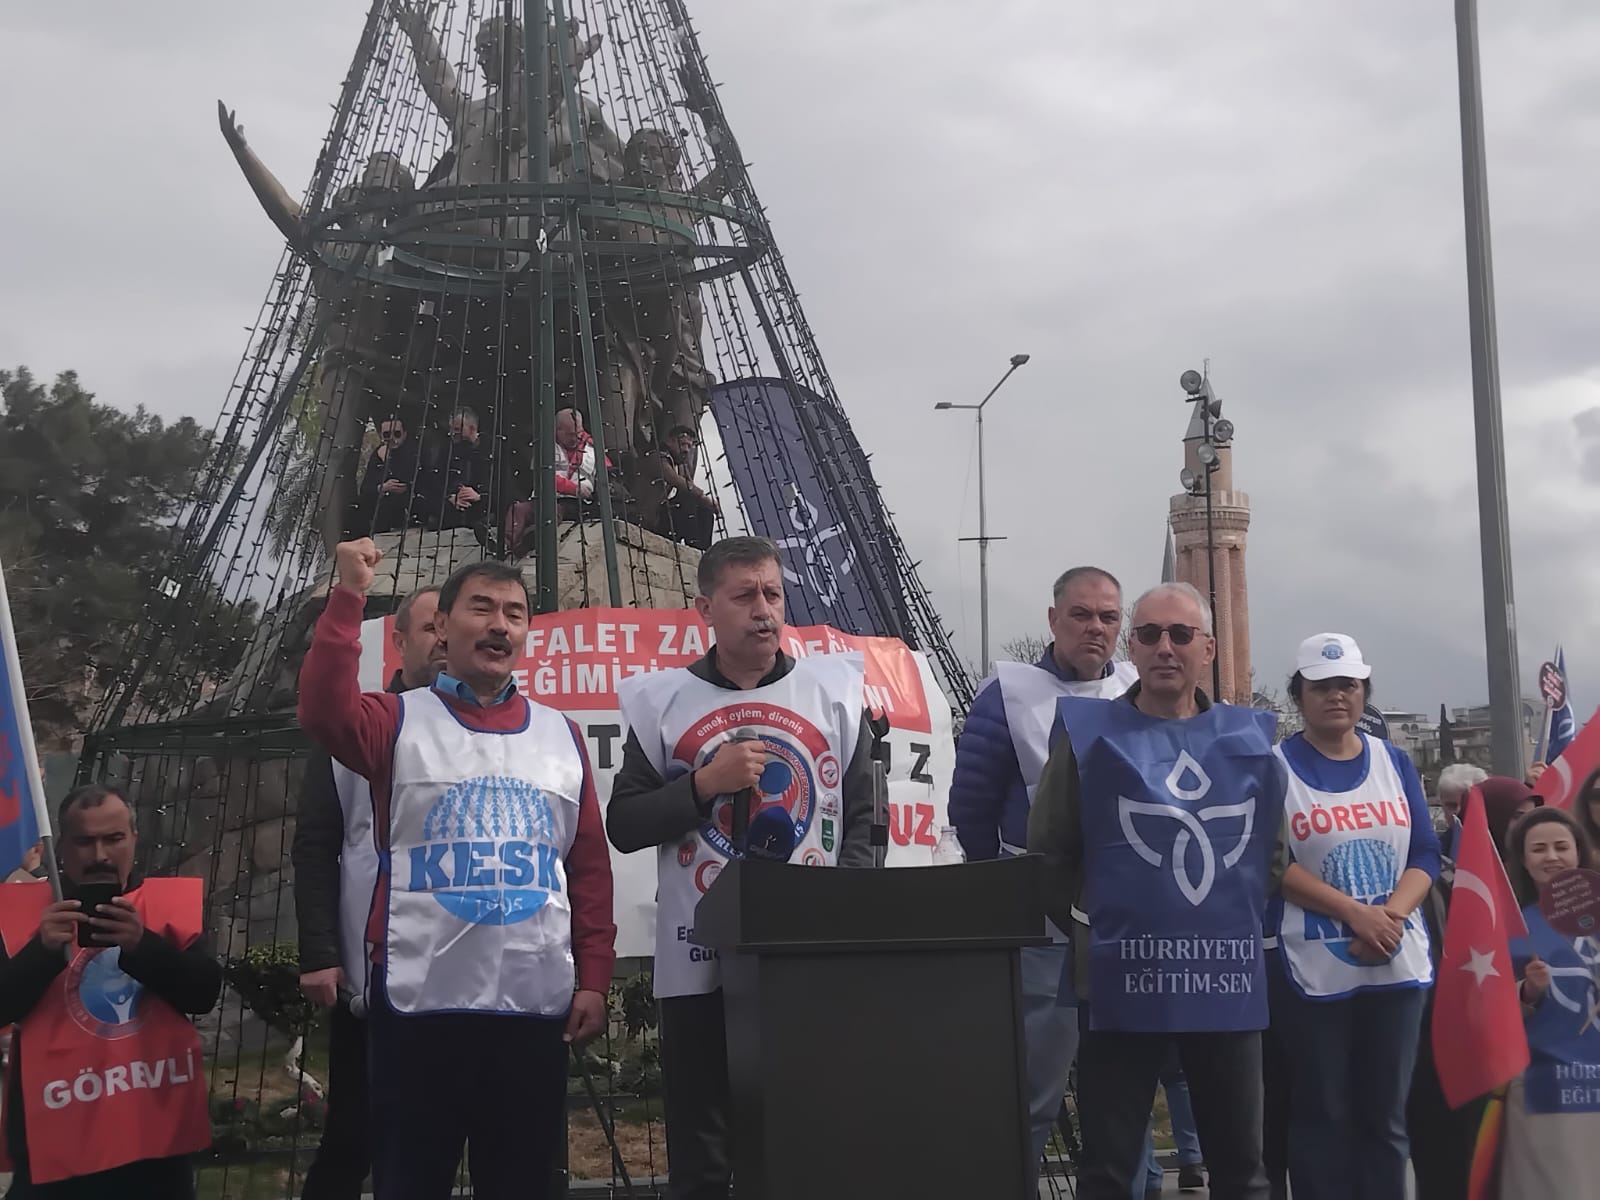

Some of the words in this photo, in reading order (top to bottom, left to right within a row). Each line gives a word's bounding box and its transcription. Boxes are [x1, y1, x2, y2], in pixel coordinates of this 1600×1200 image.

[525, 623, 640, 658] FALET
[696, 714, 728, 737] emek,
[729, 708, 766, 721] eylem,
[1291, 796, 1410, 842] GÖREVLİ
[408, 840, 562, 893] KESK
[1120, 934, 1255, 965] HÜRRİYETÇİ
[1125, 968, 1252, 994] EĞİTİM-SEN
[43, 1048, 196, 1110] GÖREVLİ
